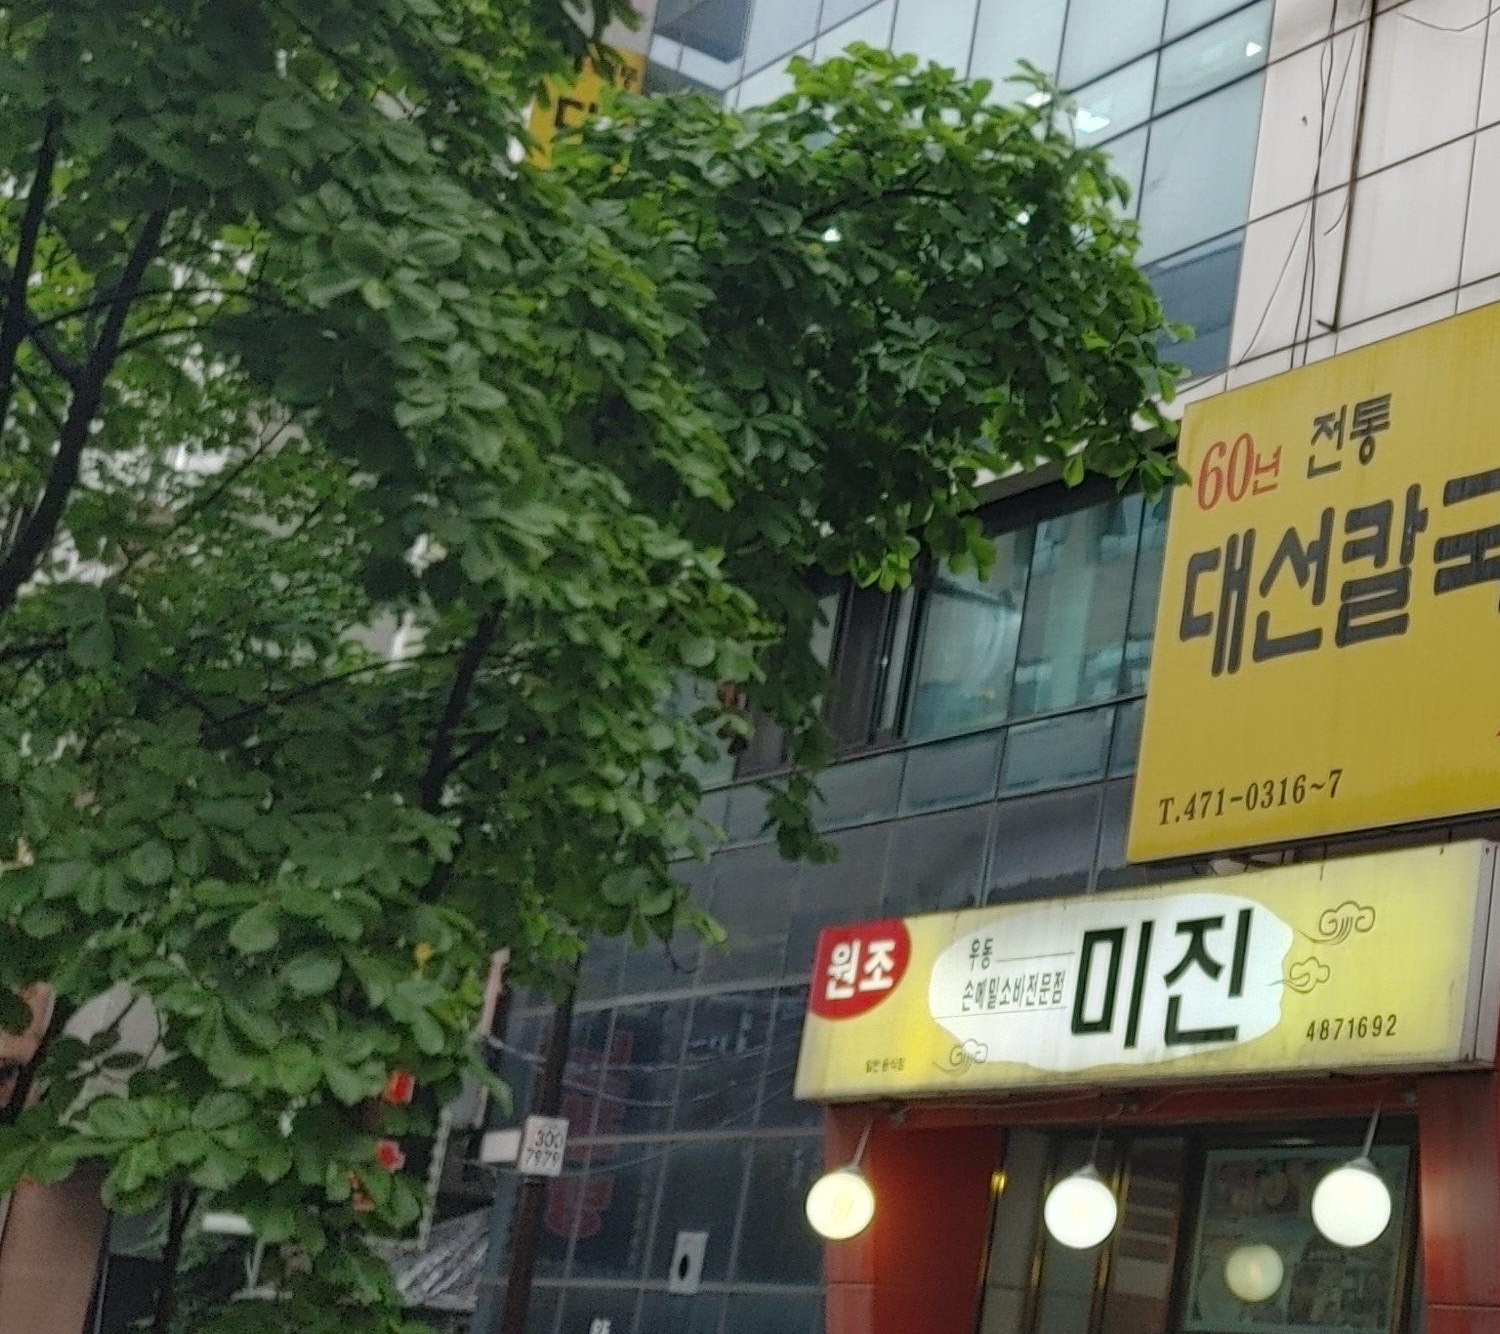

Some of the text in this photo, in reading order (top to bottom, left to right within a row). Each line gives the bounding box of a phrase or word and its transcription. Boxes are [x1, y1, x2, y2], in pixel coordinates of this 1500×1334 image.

[1196, 392, 1393, 512] 60년 전통
[824, 937, 897, 1002] 원조
[969, 937, 995, 972] 우동
[1071, 906, 1255, 1050] 미진
[1305, 1013, 1399, 1043] 4871692
